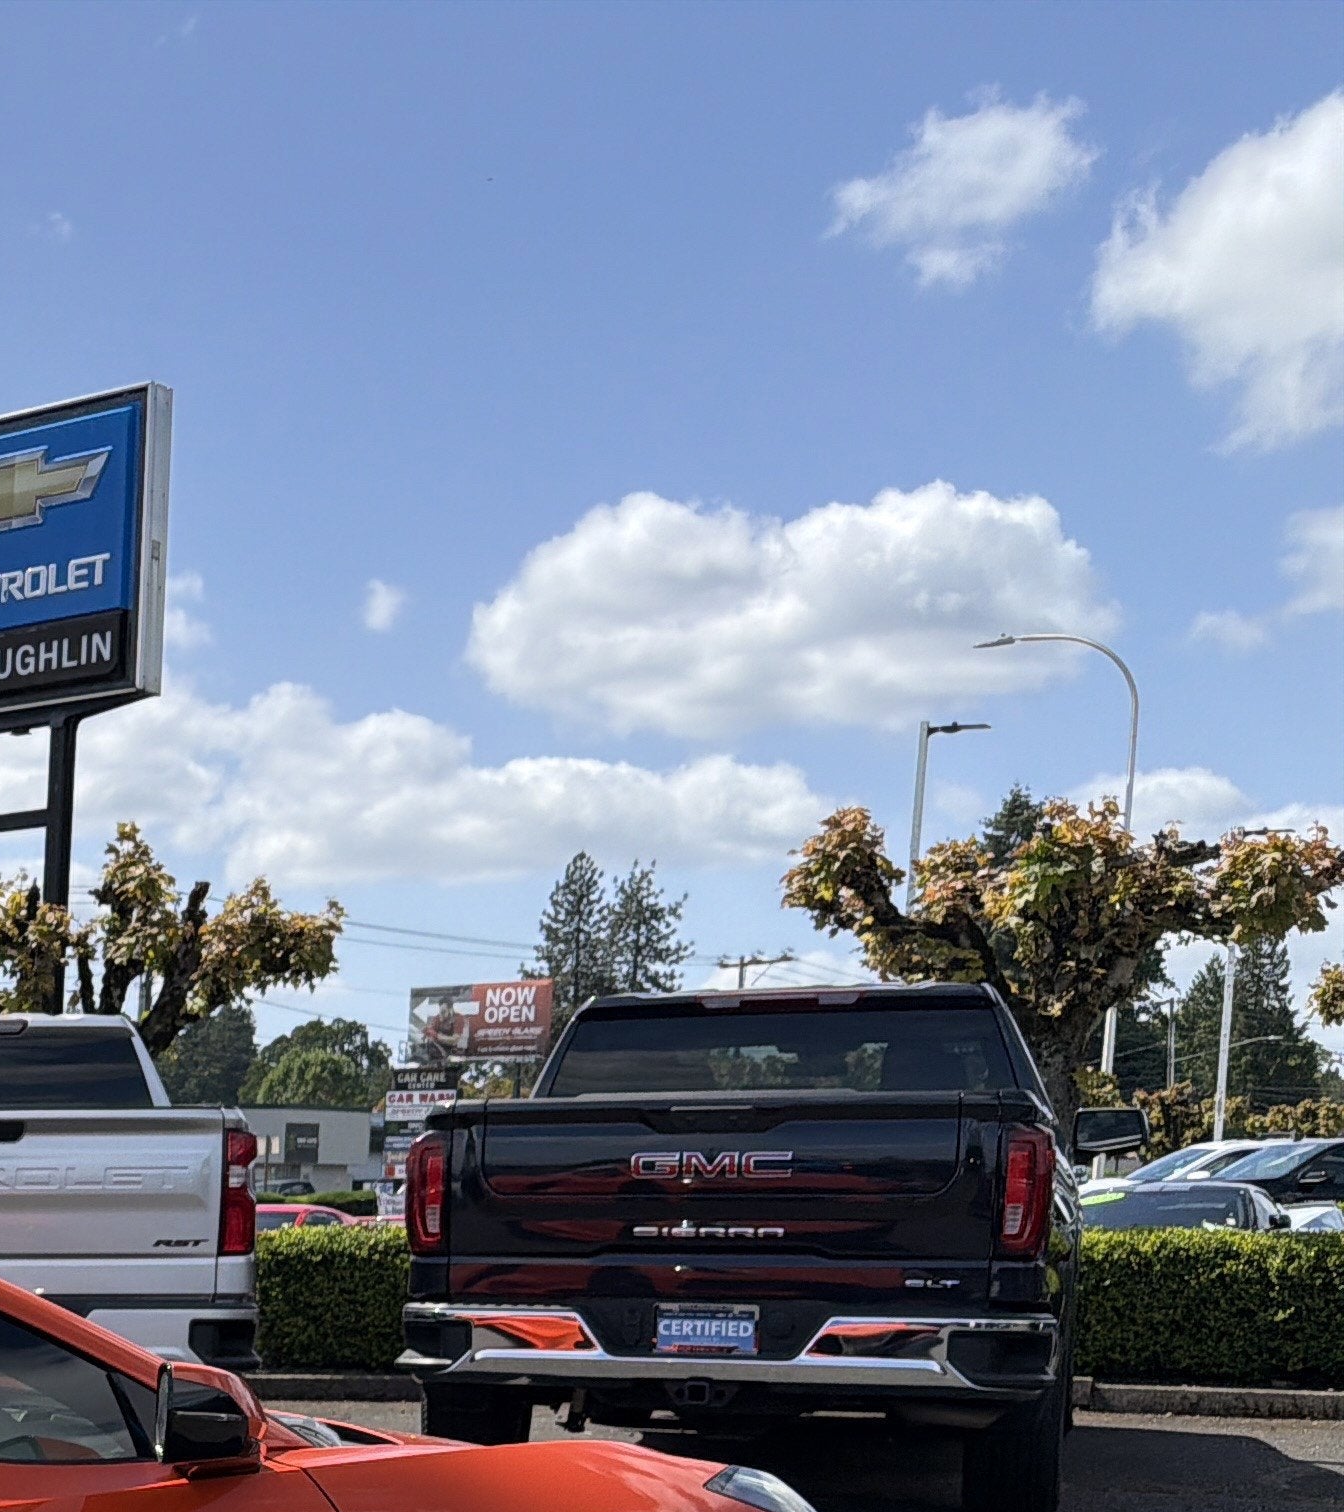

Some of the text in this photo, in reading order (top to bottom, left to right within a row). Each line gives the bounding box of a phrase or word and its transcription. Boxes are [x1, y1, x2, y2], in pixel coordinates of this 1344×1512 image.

[486, 986, 536, 1007] NOW
[485, 1005, 535, 1024] OPEN
[398, 1072, 446, 1083] CAR CARE
[388, 1093, 413, 1104] CAR
[630, 1151, 794, 1179] GMC
[632, 1226, 785, 1238] SIERRA
[153, 1239, 210, 1247] RST
[658, 1319, 753, 1337] CERTIFIED
